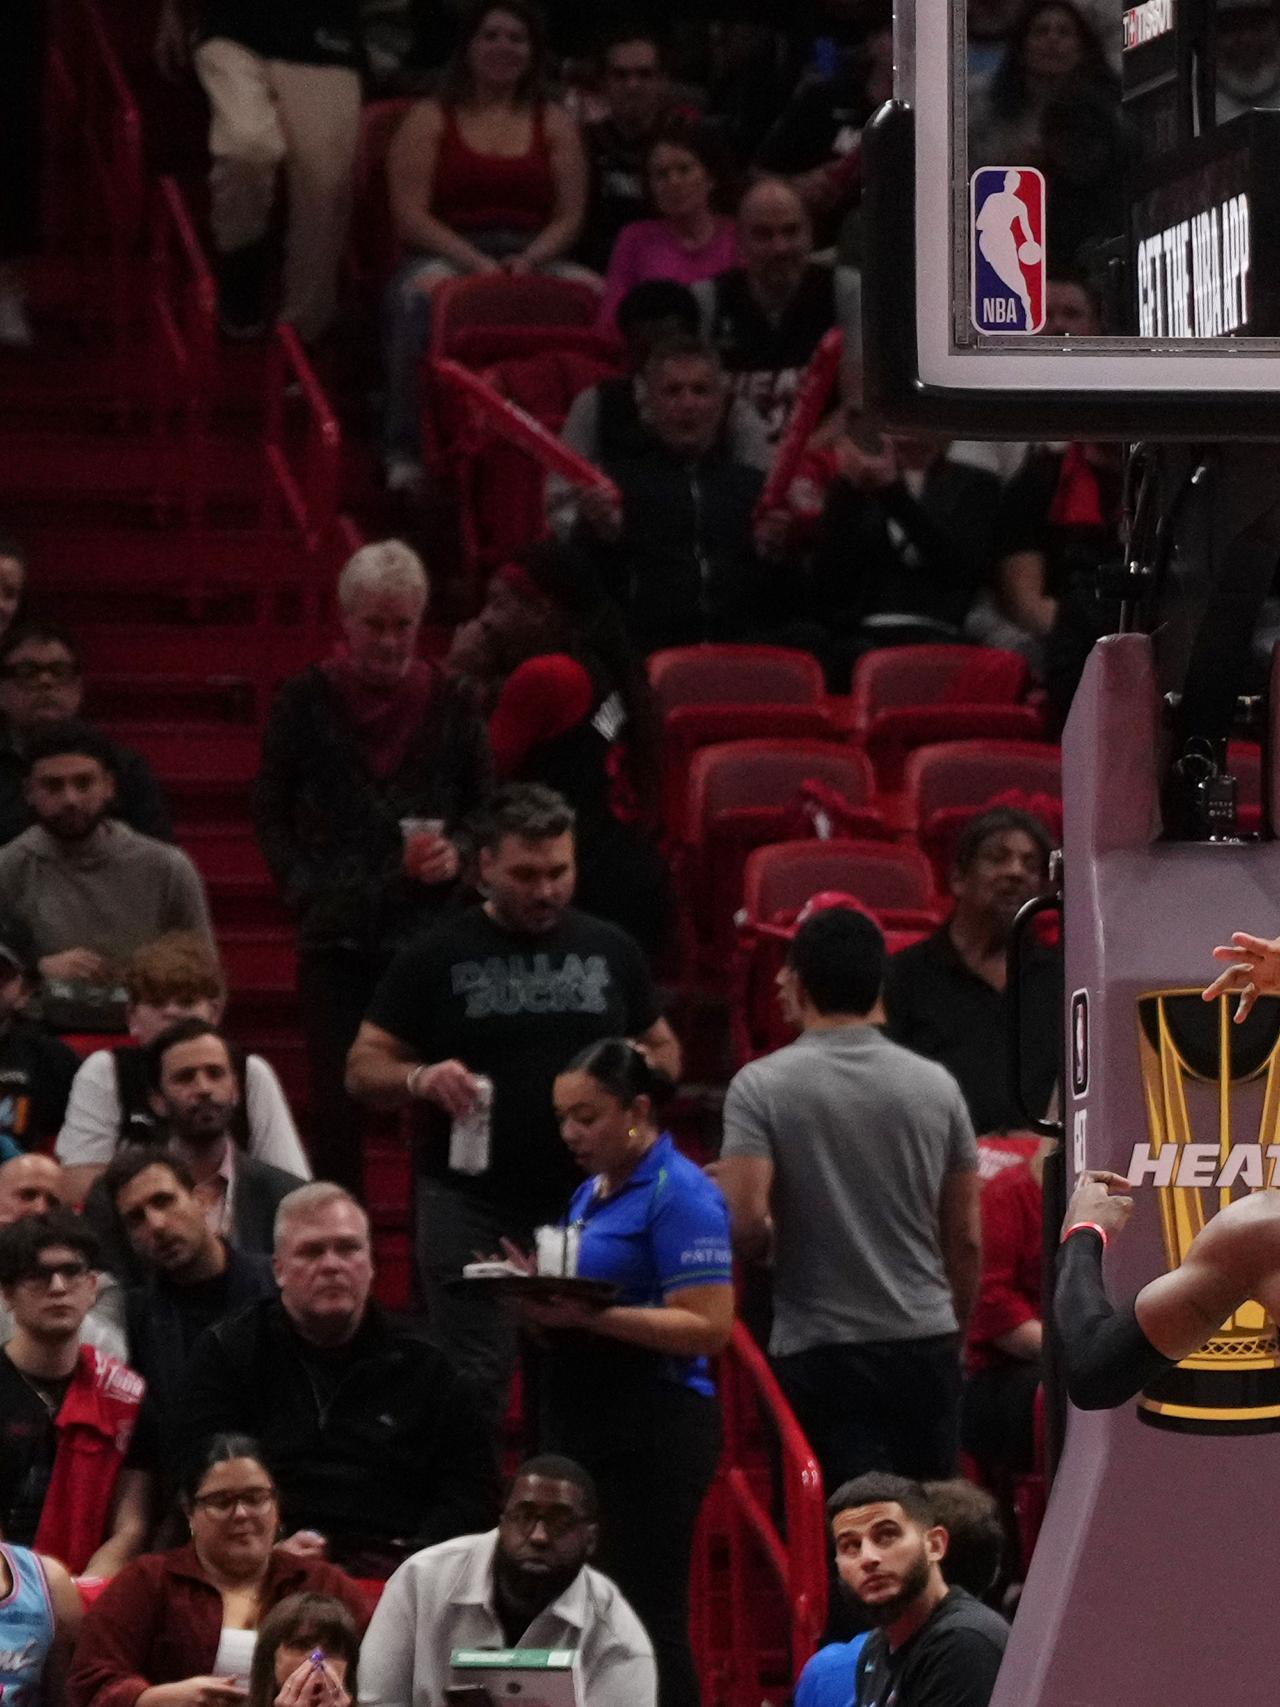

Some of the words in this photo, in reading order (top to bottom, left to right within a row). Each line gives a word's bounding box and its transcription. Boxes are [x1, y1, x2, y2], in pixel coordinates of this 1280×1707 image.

[1163, 220, 1193, 337] THE
[1191, 207, 1223, 337] NBA
[1222, 192, 1250, 333] APP
[982, 297, 1018, 323] NBA
